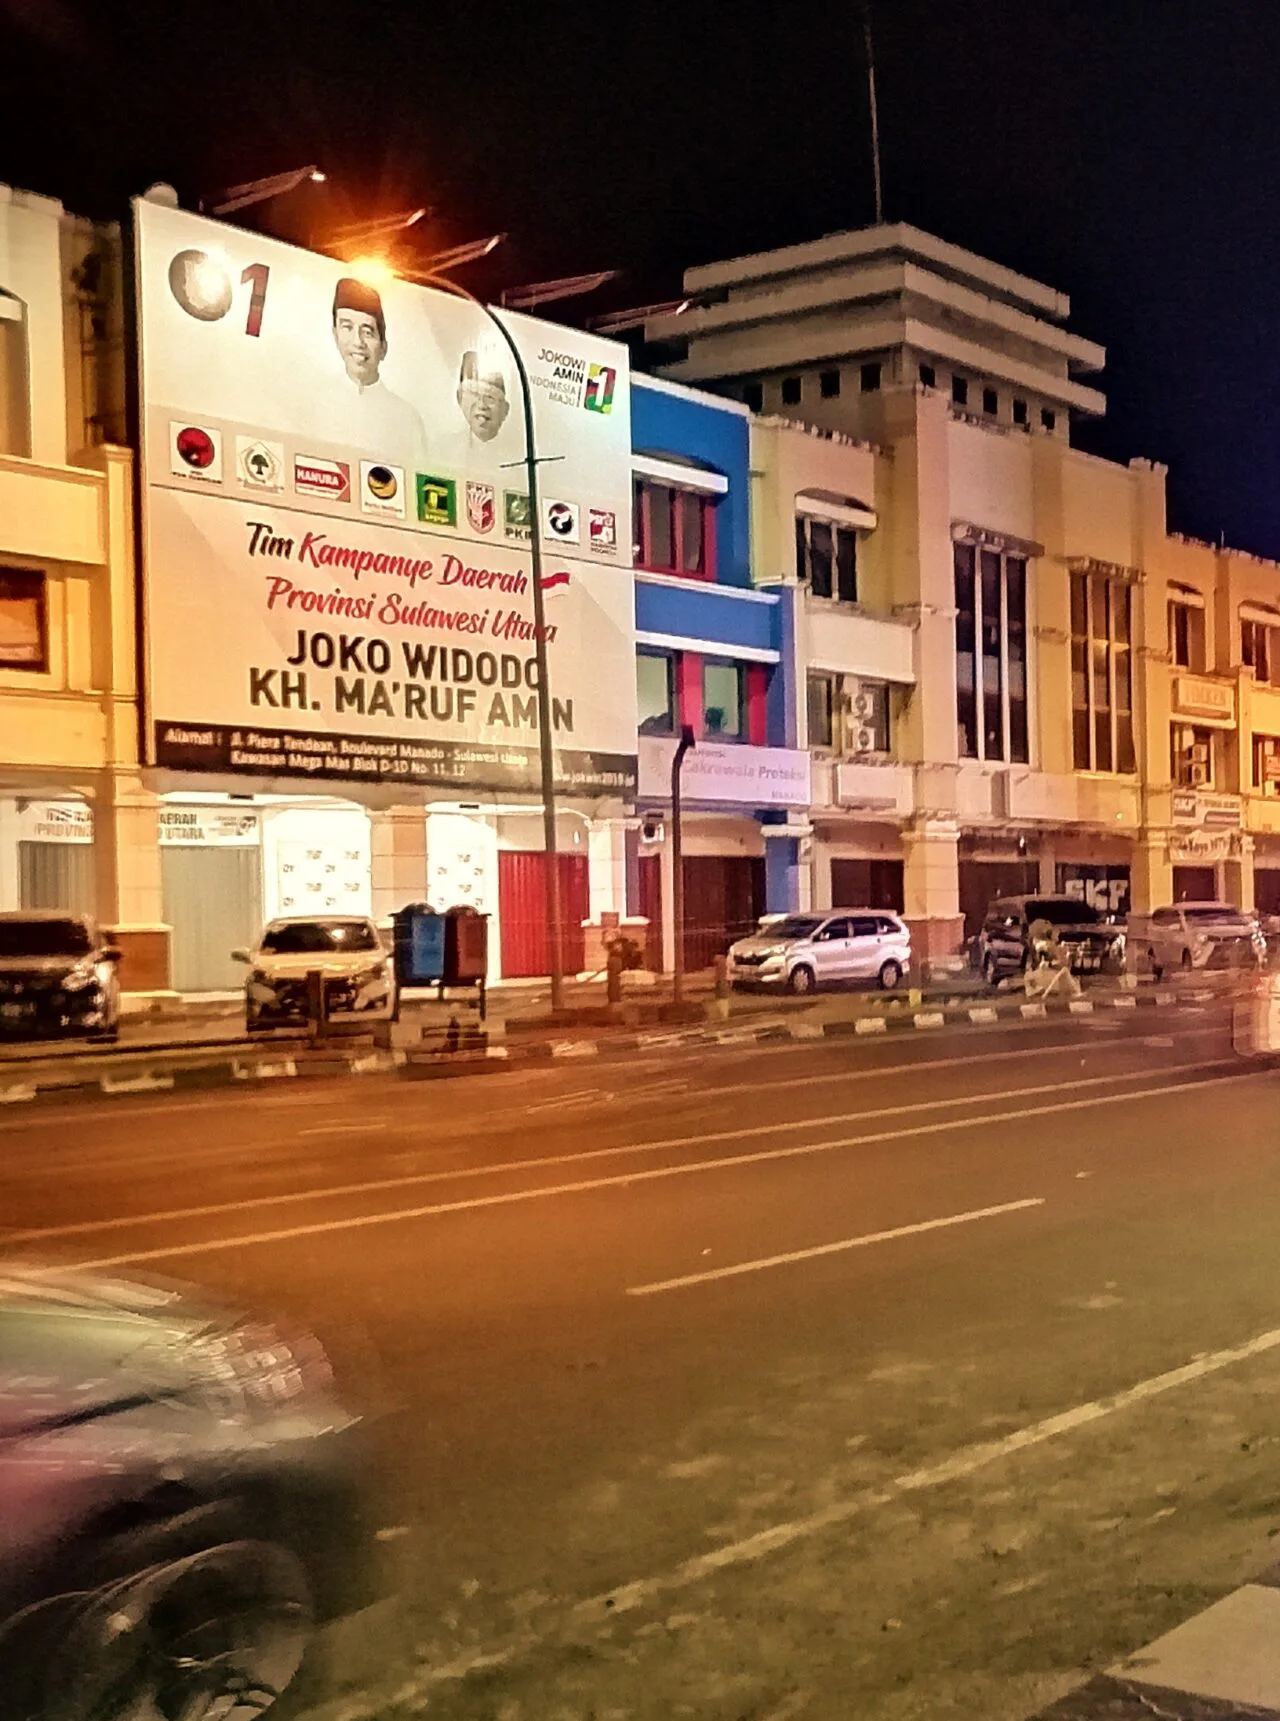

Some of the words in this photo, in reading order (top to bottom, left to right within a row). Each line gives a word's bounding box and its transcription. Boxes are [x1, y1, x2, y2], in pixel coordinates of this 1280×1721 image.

[537, 348, 586, 371] JOKOWI
[553, 367, 584, 384] AMIN
[548, 391, 576, 407] MAJU
[297, 469, 339, 486] HANURA
[246, 522, 294, 560] Tim
[299, 532, 433, 588] Kampanye
[436, 554, 528, 595] Daerah
[266, 576, 377, 619] Provinsi
[378, 593, 489, 634] Sulawesi
[287, 630, 391, 675] JOKO
[250, 667, 321, 711] KH.
[335, 676, 477, 723] MA'RUF
[486, 692, 574, 732] AMN
